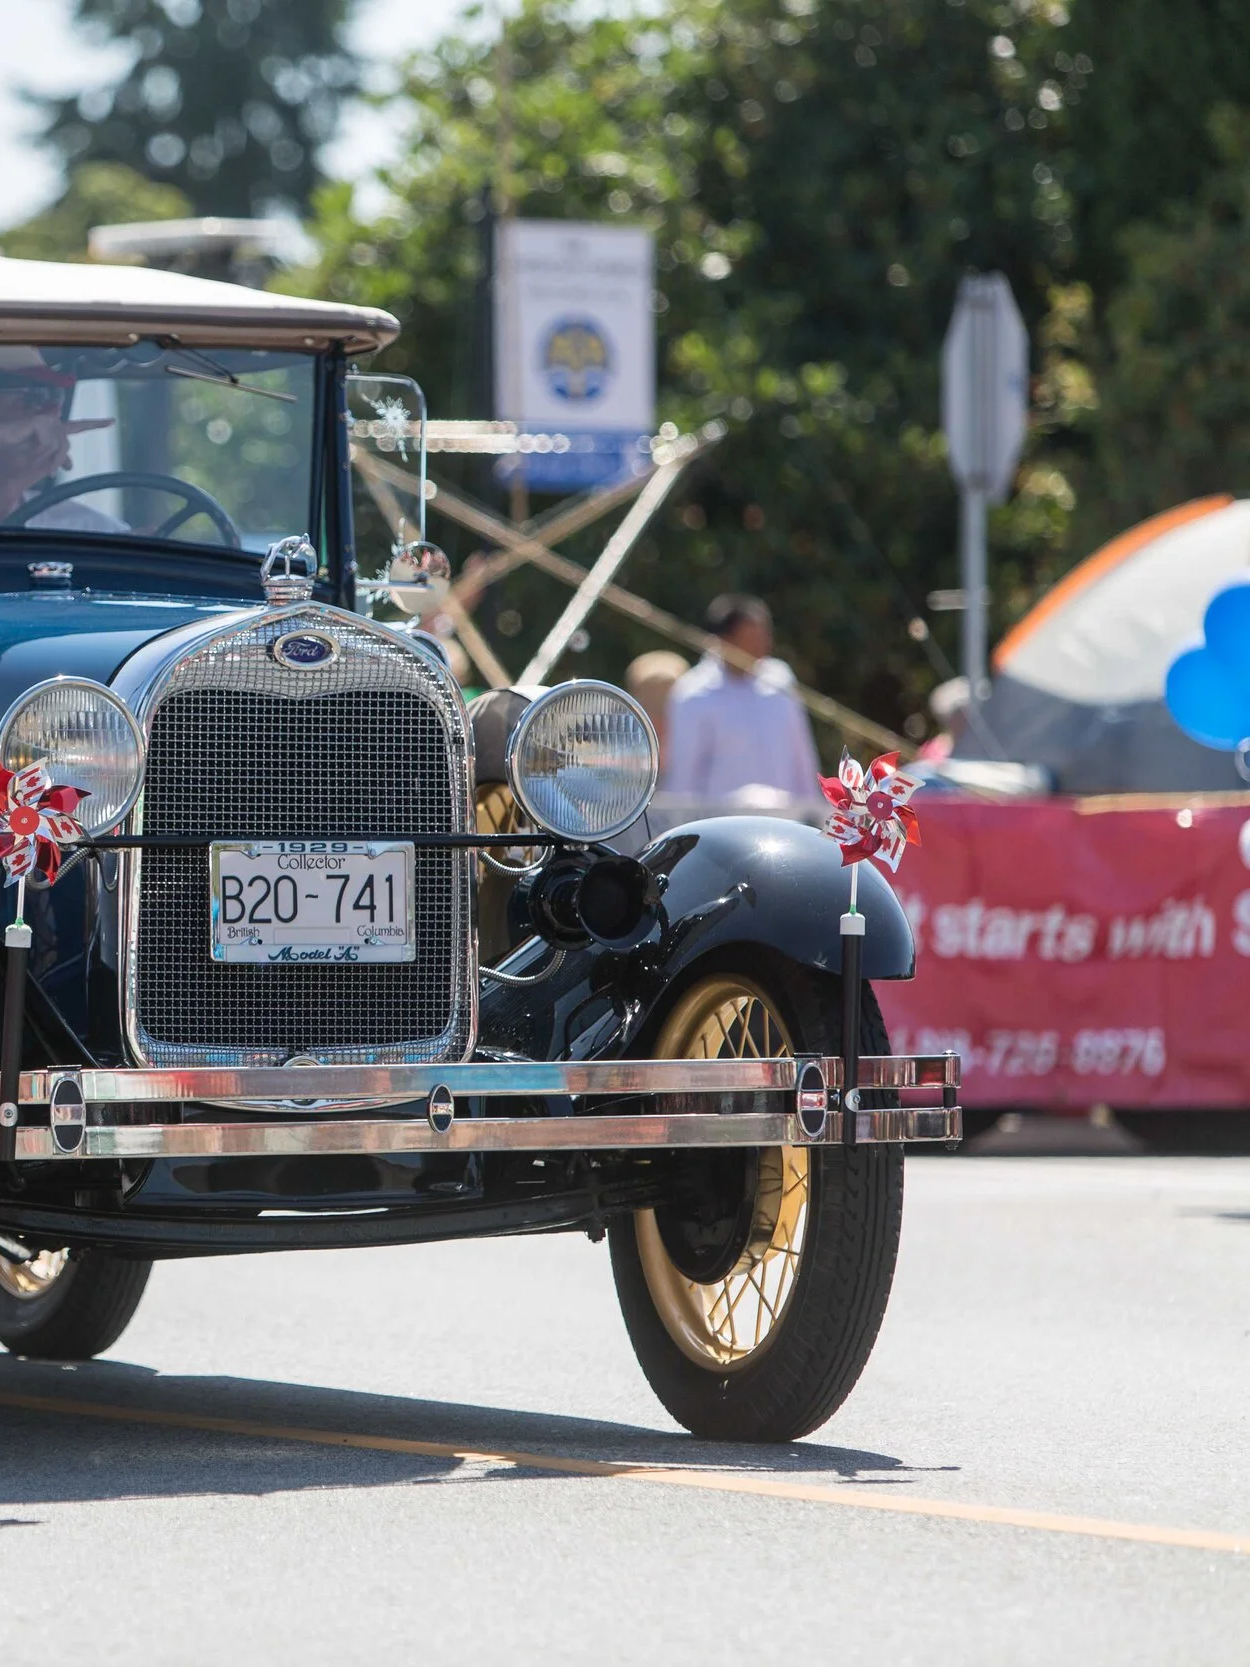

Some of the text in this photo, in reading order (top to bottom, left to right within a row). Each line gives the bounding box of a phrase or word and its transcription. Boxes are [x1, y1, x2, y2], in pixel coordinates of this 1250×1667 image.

[282, 641, 319, 657] Ford
[277, 854, 346, 870] Collector
[222, 873, 395, 924] B20-741
[227, 925, 405, 939] British Columbia
[931, 896, 1098, 962] starts
[1106, 893, 1217, 958] with
[268, 946, 332, 961] Model
